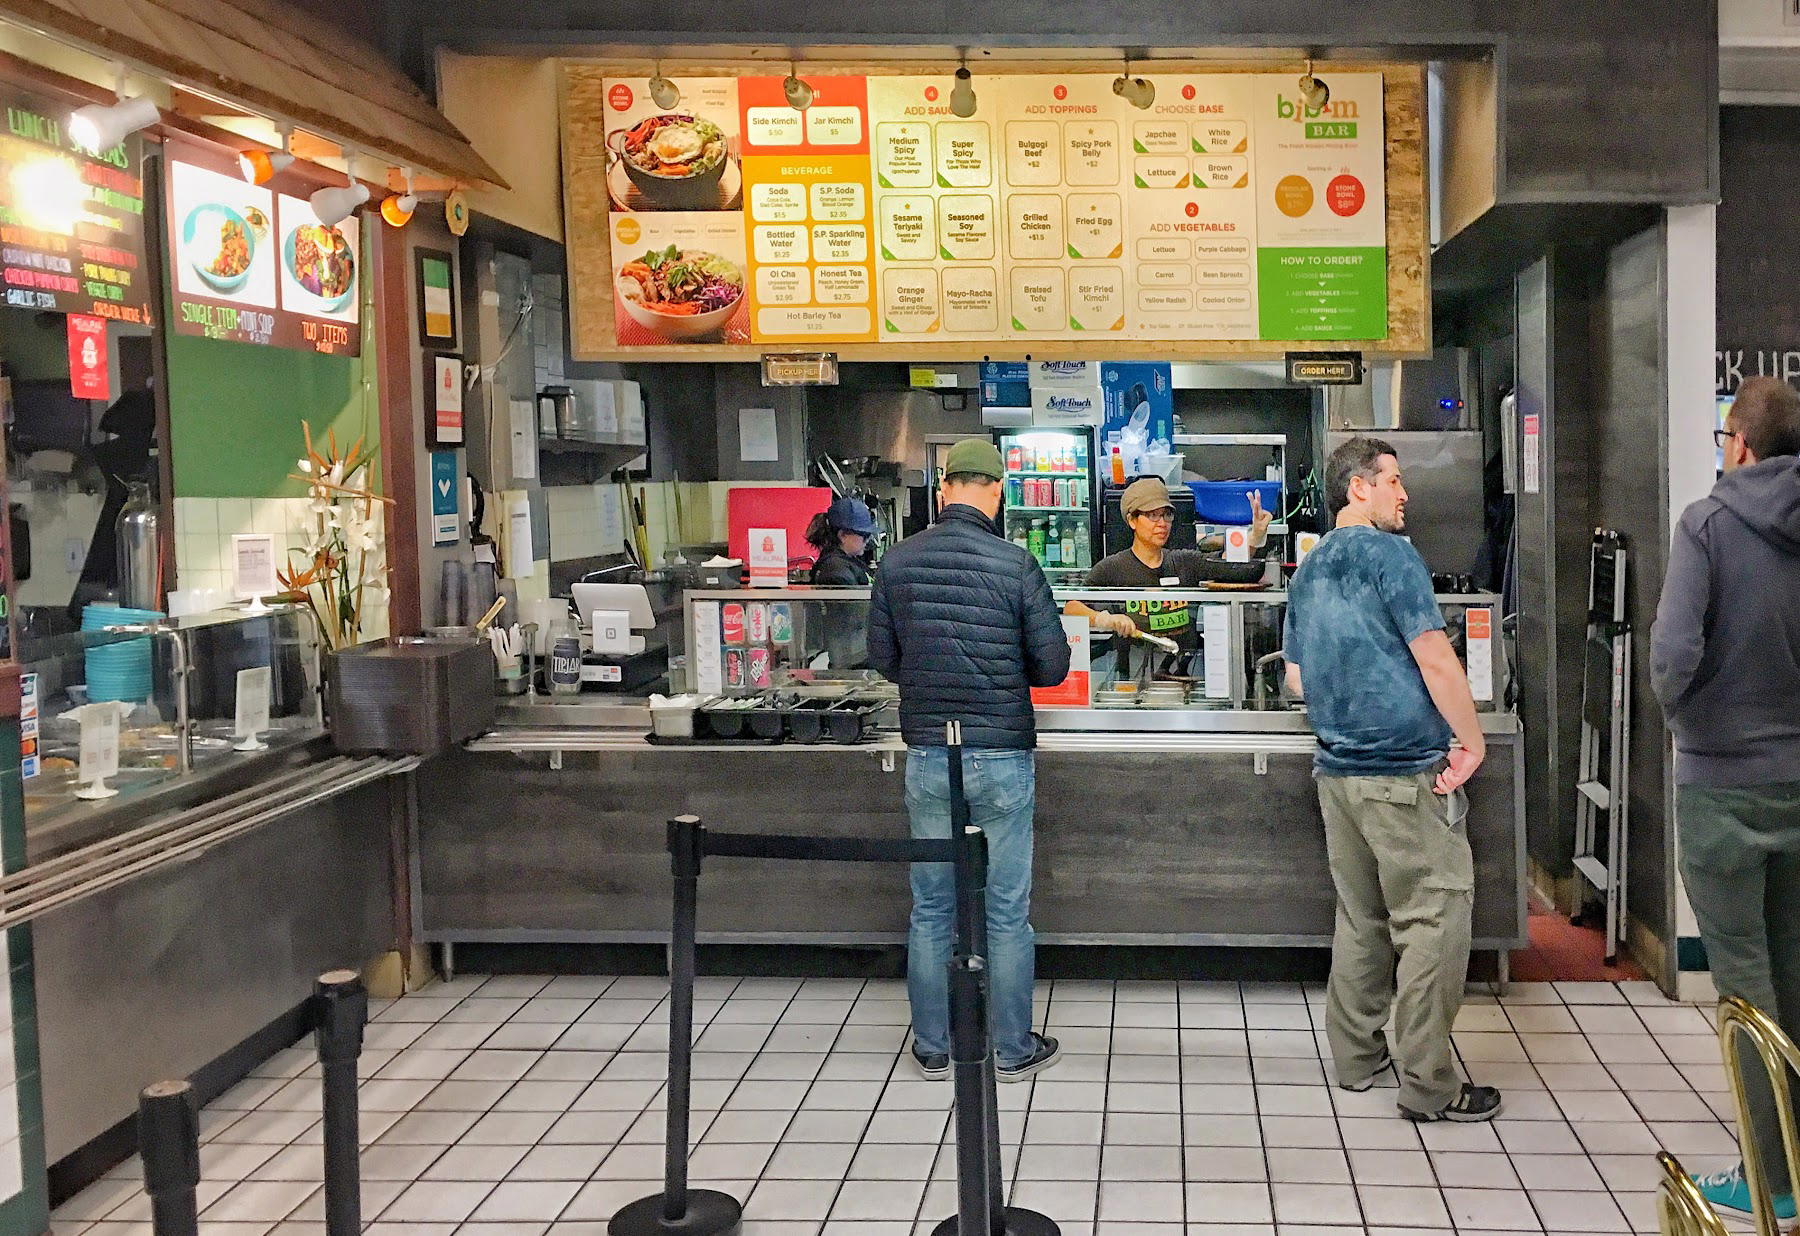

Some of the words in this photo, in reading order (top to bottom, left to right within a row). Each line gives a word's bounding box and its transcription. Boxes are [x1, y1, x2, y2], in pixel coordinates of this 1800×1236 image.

[904, 107, 925, 115] ADD
[1049, 105, 1097, 113] TOPPINGS
[1155, 105, 1196, 113] CHOOSE
[1199, 105, 1224, 113] BASE
[1313, 125, 1349, 136] BAR
[1145, 131, 1176, 139] Japchae
[889, 137, 919, 145] Medium
[1018, 141, 1047, 149] Bulgogi
[894, 147, 915, 155] Spicy
[953, 150, 974, 158] Spicy
[1082, 149, 1101, 157] Belly
[781, 167, 833, 175] BEVERAGE
[1098, 218, 1112, 226] Egg
[1150, 224, 1170, 232] ADD
[1174, 224, 1236, 232] VEGETABLES
[1280, 257, 1304, 265] HOW
[1308, 256, 1321, 264] TO
[1324, 255, 1363, 264] ORDER?
[897, 287, 925, 295] Orange
[947, 290, 992, 298] Mayo-Racha
[1030, 294, 1046, 302] Tofu
[1084, 294, 1109, 302] Kimchi
[803, 312, 826, 320] Barley
[302, 322, 316, 341] TWO
[323, 324, 347, 345] ITEMS
[777, 368, 802, 376] PICKUP
[1301, 367, 1325, 375] ORDER
[1046, 396, 1065, 409] Soft
[1066, 398, 1091, 407] Touch
[1156, 614, 1185, 626] BAR
